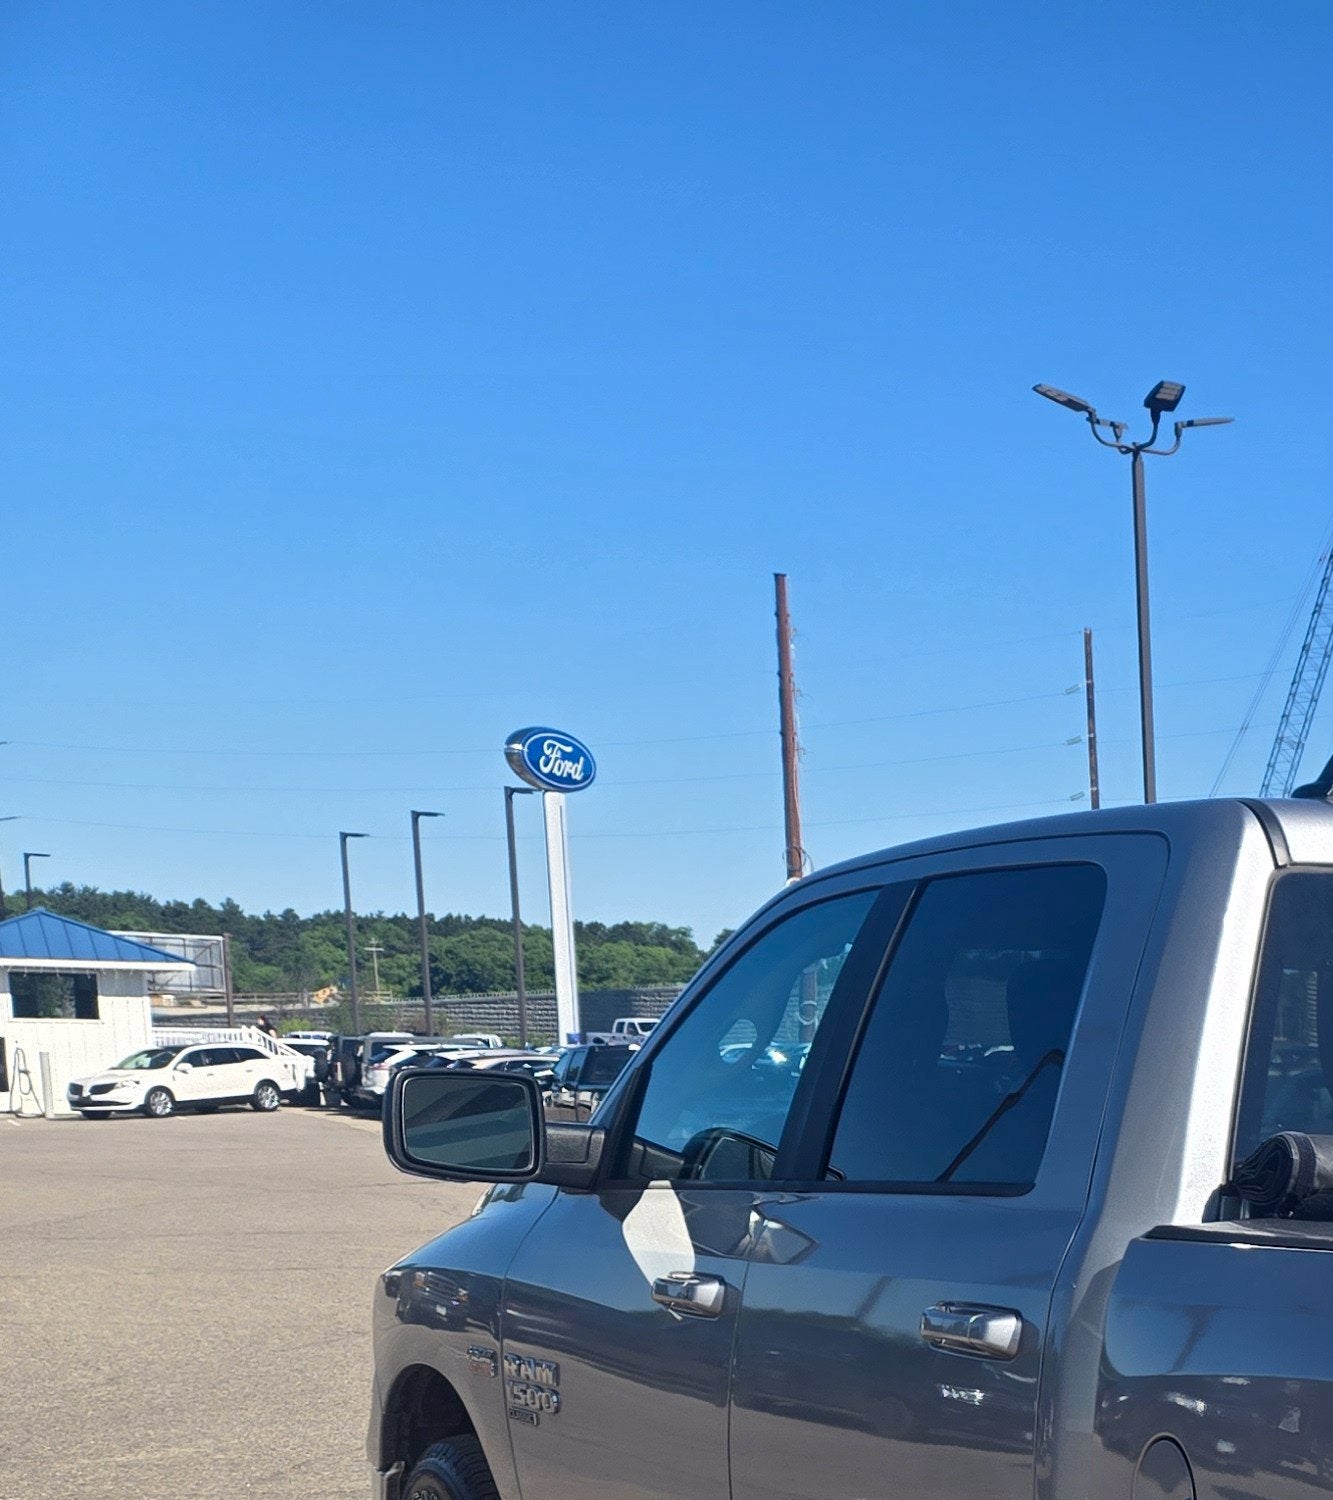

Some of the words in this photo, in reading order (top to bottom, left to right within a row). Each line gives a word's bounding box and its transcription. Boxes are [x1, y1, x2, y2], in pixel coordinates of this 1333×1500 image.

[539, 739, 584, 781] Ford
[503, 1352, 559, 1387] RAM
[505, 1380, 560, 1414] 1500
